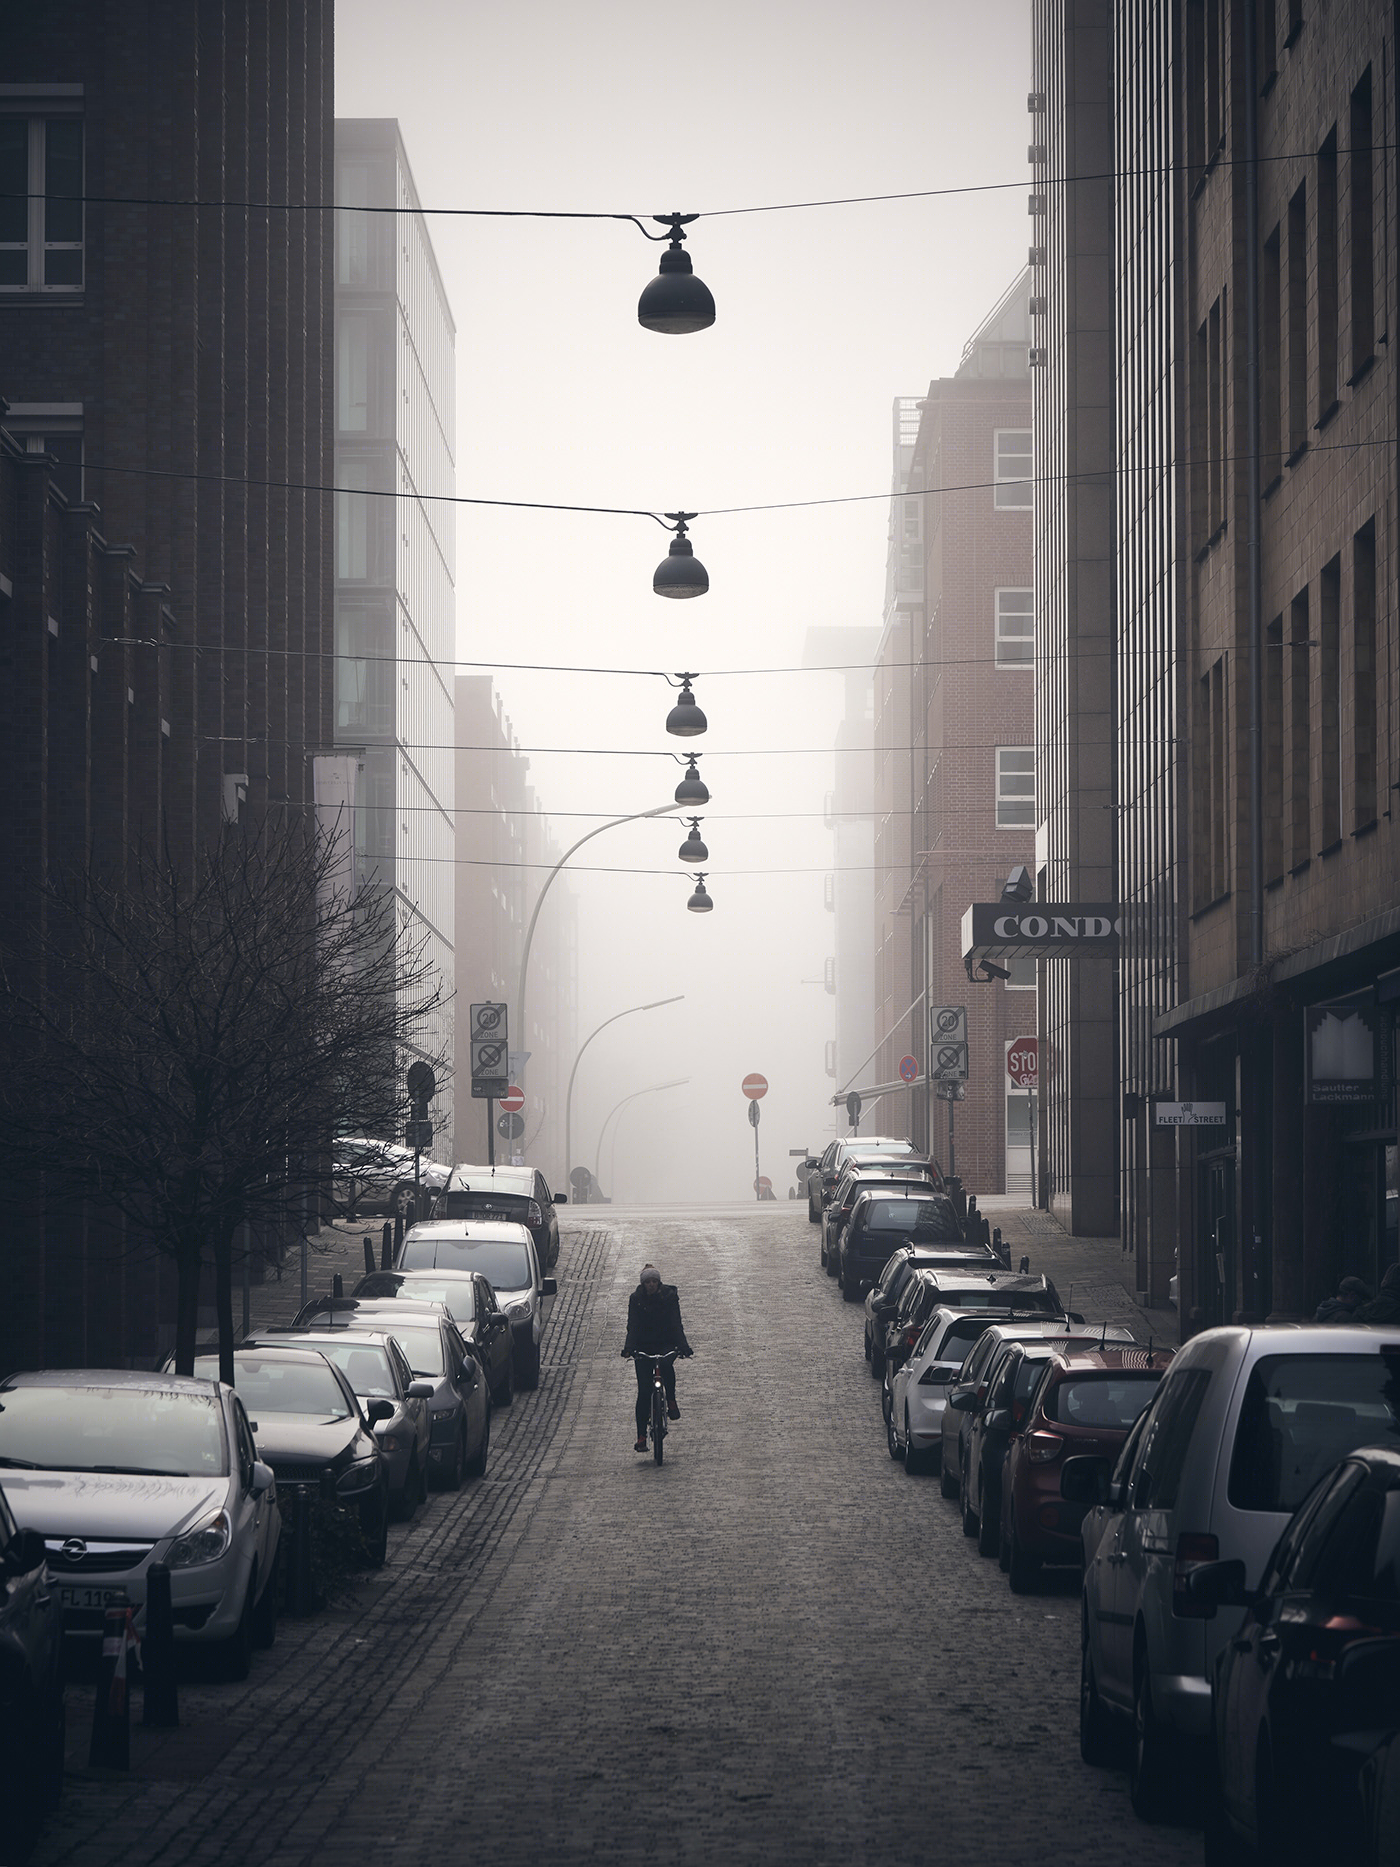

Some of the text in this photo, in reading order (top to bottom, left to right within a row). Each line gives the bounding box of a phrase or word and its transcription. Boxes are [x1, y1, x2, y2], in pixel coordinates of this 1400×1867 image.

[993, 915, 1121, 938] COND
[482, 1013, 496, 1025] 20
[941, 1015, 955, 1027] 20
[1010, 1051, 1037, 1072] STO
[942, 1070, 958, 1078] ONE
[1312, 1084, 1359, 1092] Sautter
[1312, 1093, 1375, 1101] Lackmann
[1158, 1116, 1224, 1124] FLEET STREET
[61, 1589, 80, 1606] FL
